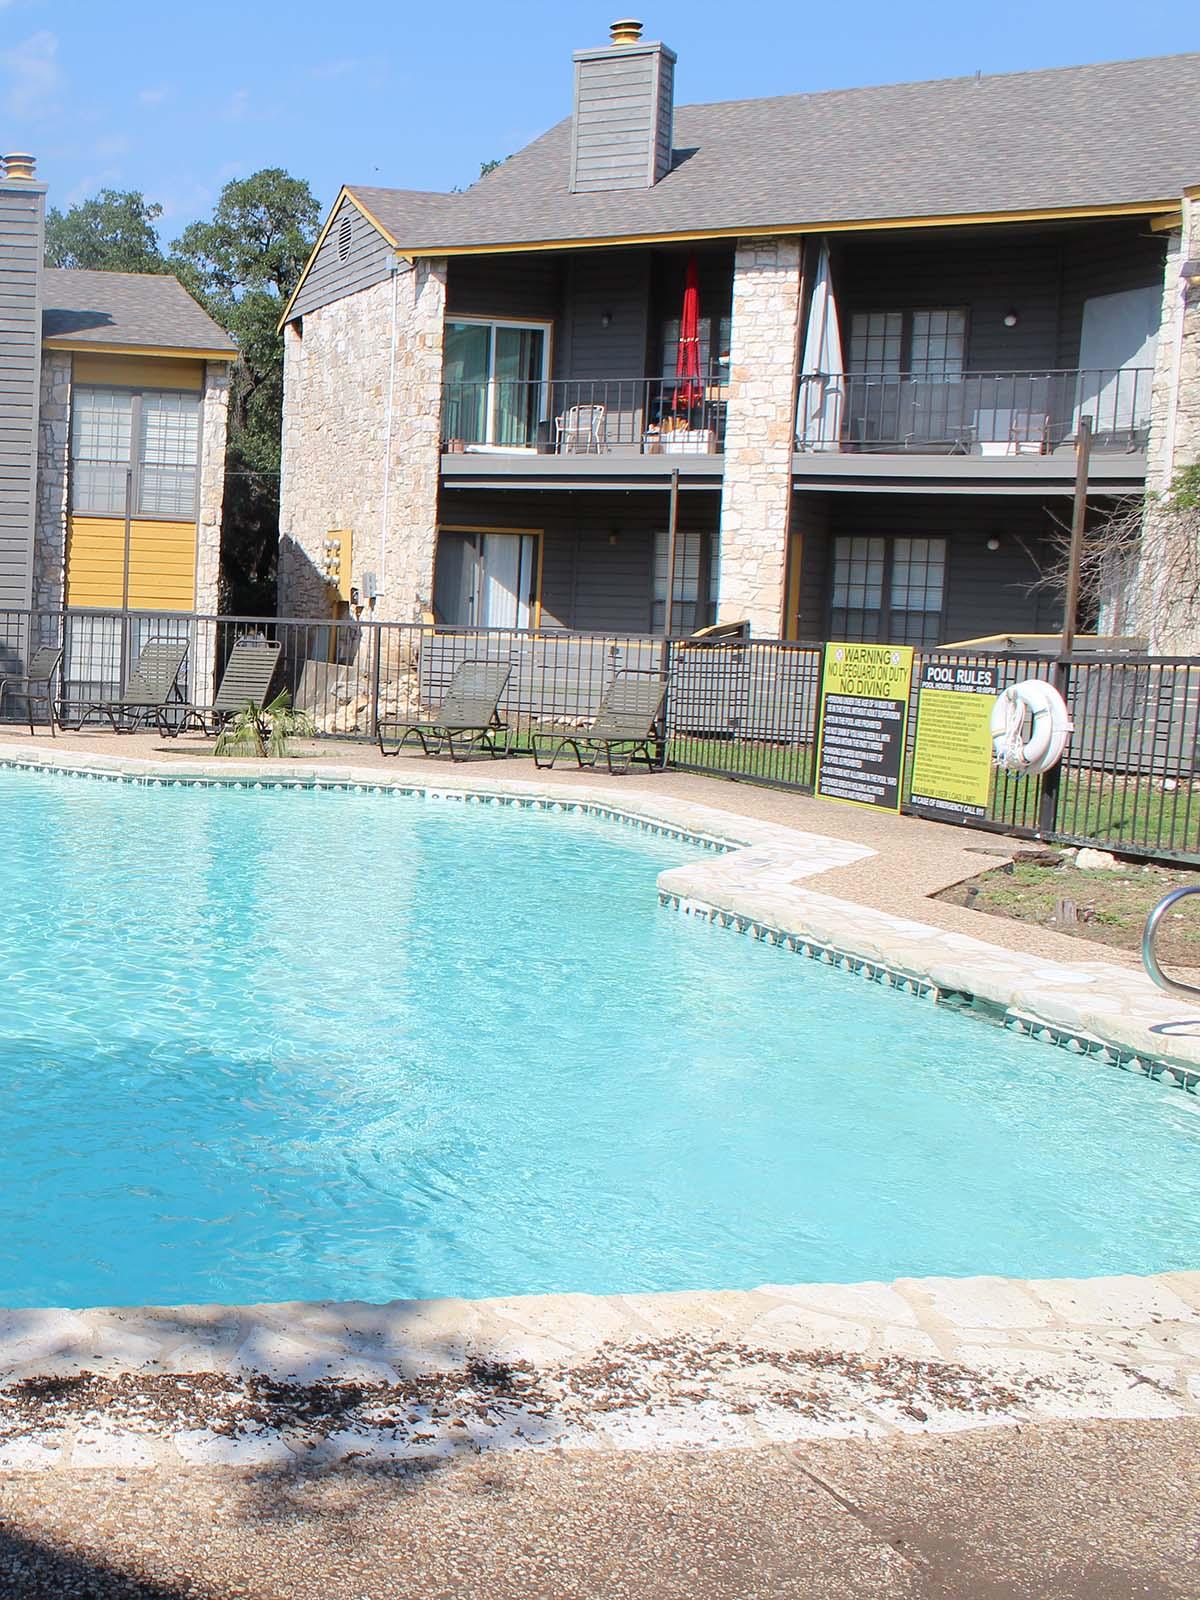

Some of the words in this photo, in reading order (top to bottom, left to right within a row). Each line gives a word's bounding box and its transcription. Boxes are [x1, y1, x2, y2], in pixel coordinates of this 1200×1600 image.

[844, 648, 891, 664] WARNING
[828, 663, 838, 676] NO
[839, 664, 876, 679] LIFEGUARD
[878, 667, 888, 681] ON
[889, 667, 909, 682] DUTY
[927, 667, 954, 682] POOL
[956, 670, 991, 686] RULES
[840, 678, 855, 693] NO
[857, 680, 890, 697] DIVING
[921, 681, 934, 689] POOL
[917, 796, 929, 806] CASE
[929, 798, 936, 807] OF
[963, 805, 976, 815] CALL
